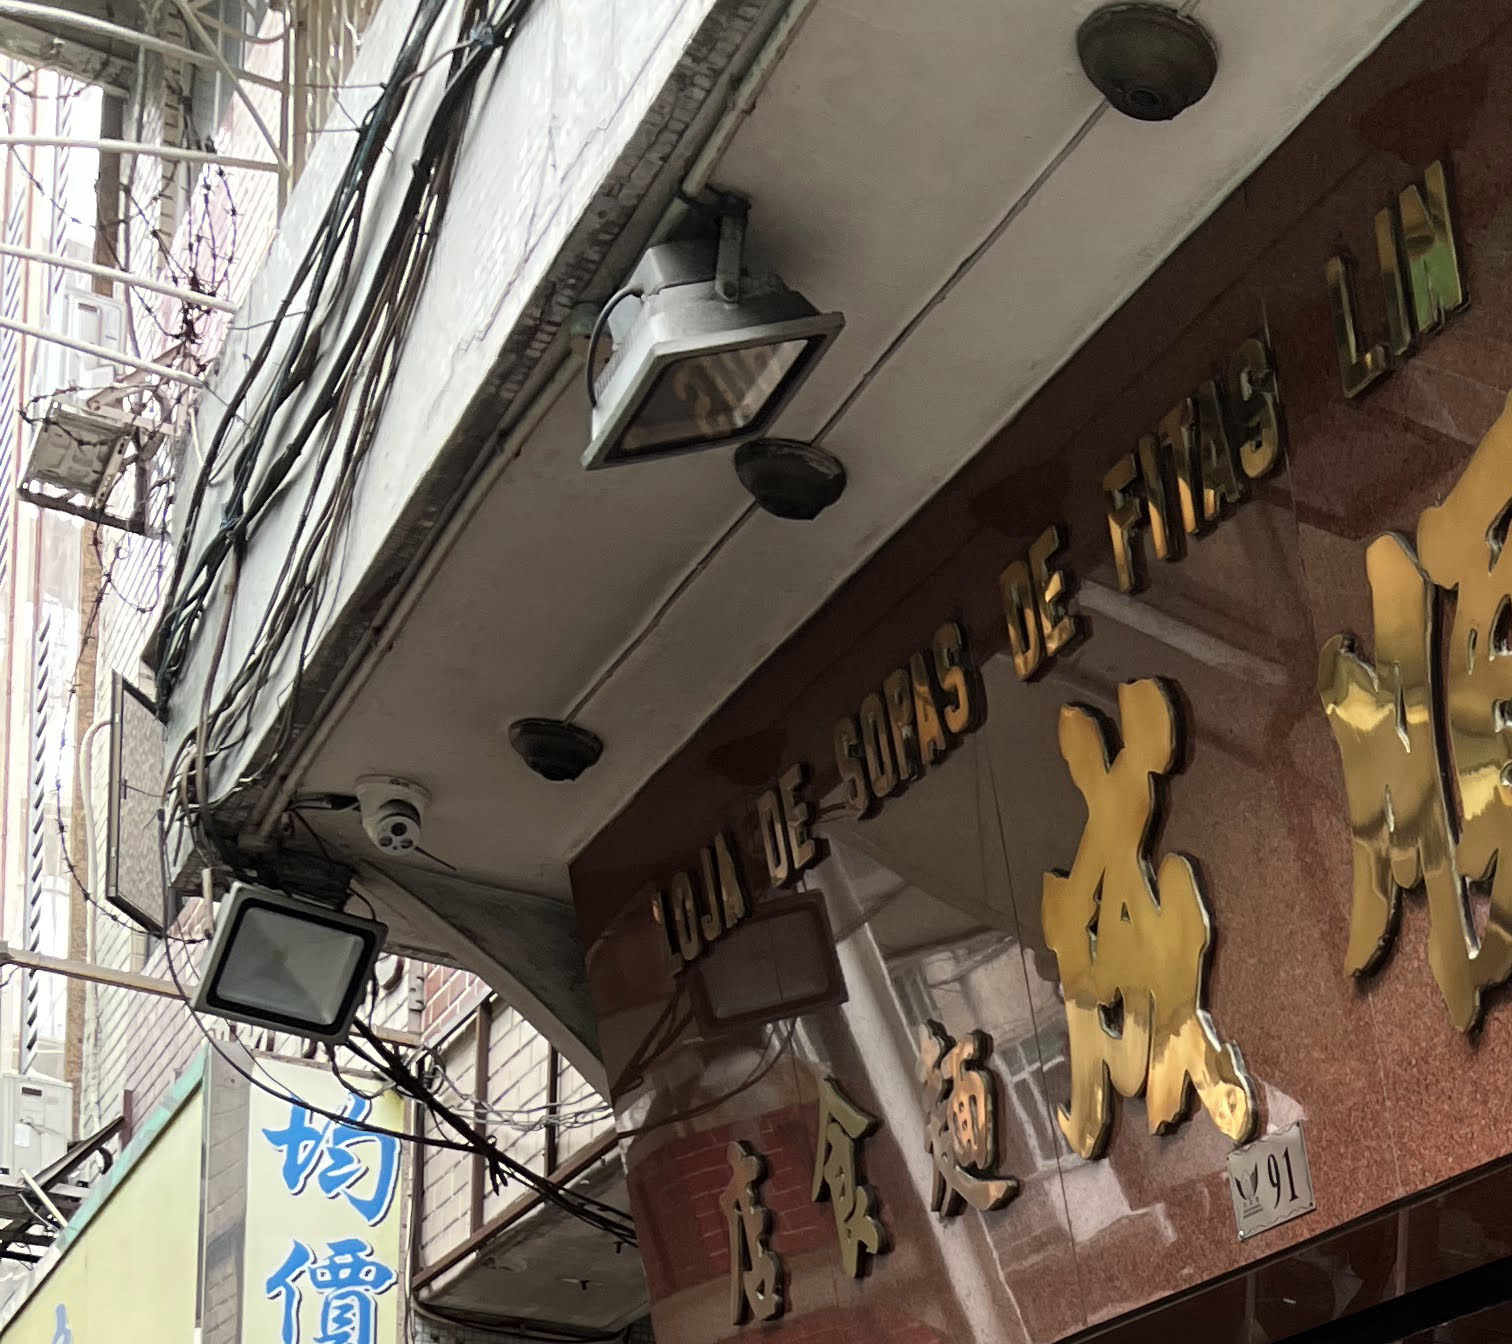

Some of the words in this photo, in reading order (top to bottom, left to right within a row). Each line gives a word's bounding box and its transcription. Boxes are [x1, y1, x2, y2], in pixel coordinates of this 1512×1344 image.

[651, 832, 746, 976] LOJA
[757, 763, 816, 888] DE
[835, 621, 972, 818] SOPAS
[999, 525, 1077, 682] DE
[1102, 338, 1280, 592] FITAS
[1323, 160, 1464, 399] LIN
[1266, 1146, 1299, 1210] 91
